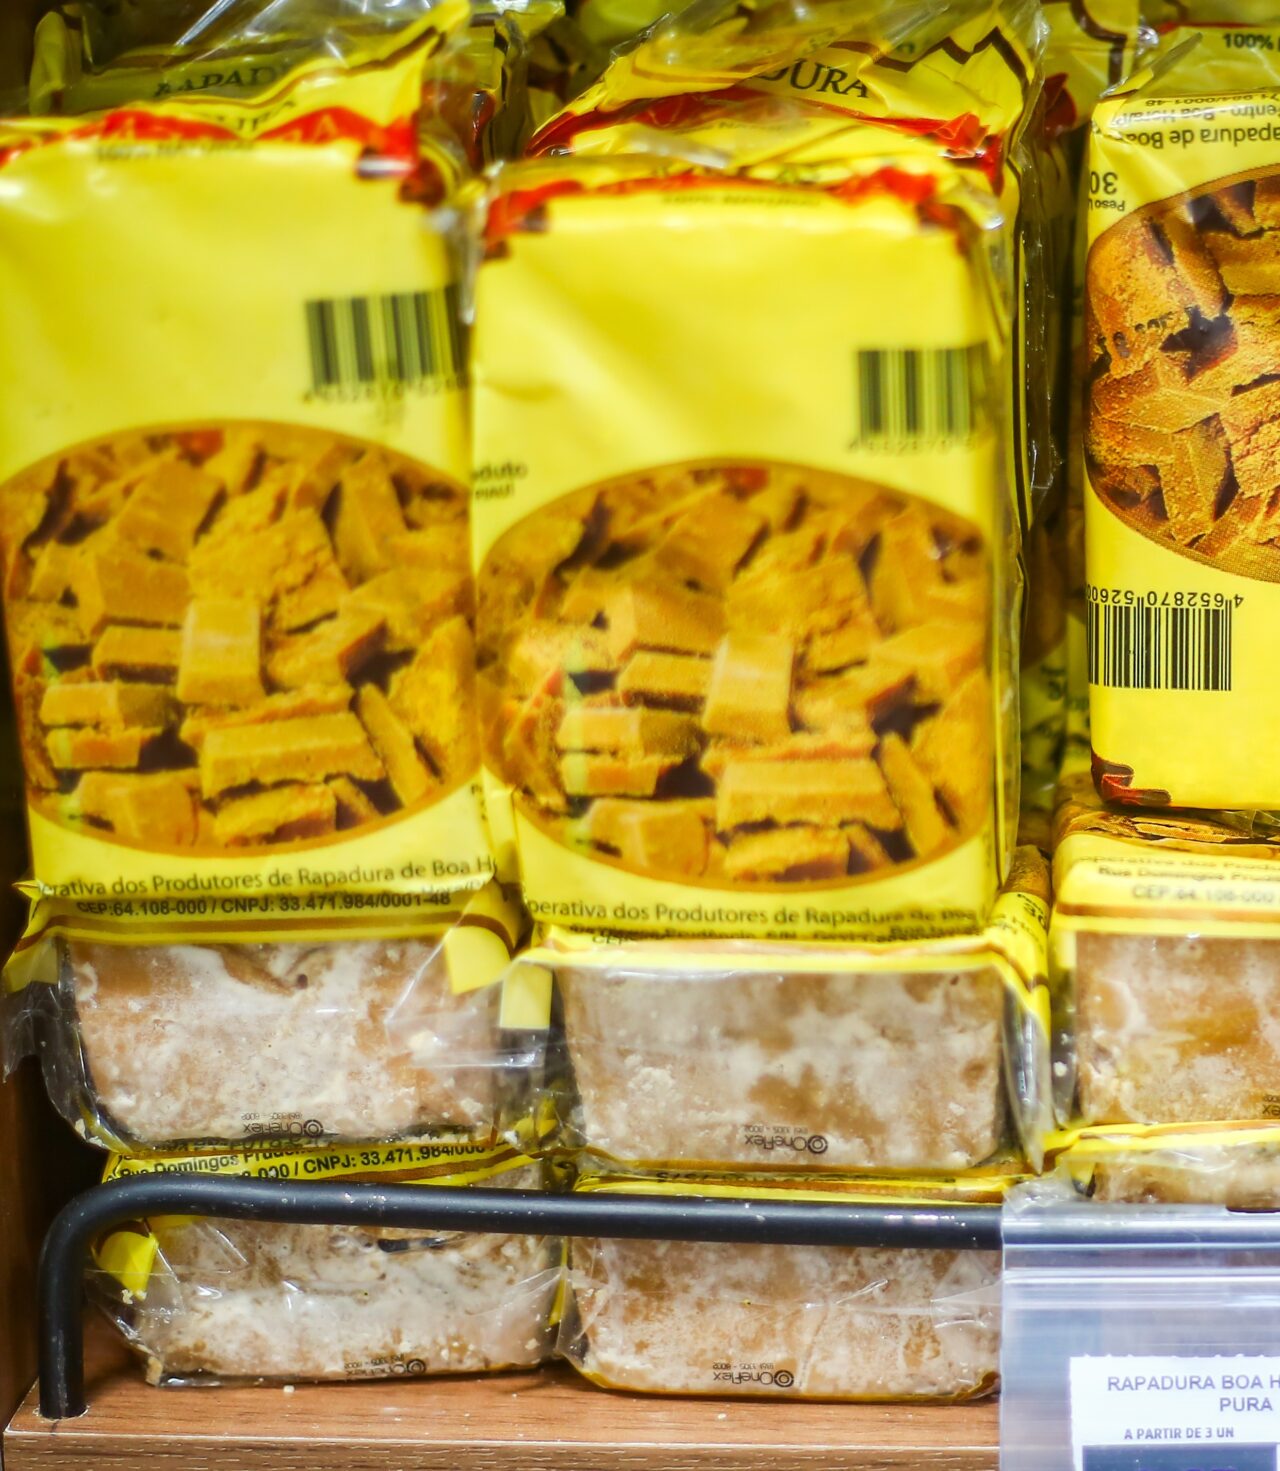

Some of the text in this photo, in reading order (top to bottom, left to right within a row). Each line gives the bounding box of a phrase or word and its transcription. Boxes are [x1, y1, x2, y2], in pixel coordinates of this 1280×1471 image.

[1222, 32, 1274, 50] 100%
[1169, 129, 1195, 148] de
[1146, 590, 1225, 608] 652870
[1233, 593, 1245, 609] 4
[111, 875, 148, 895] dos
[151, 867, 263, 893] Produtores
[267, 868, 293, 887] de
[298, 865, 395, 887] Rapadura
[400, 860, 427, 878] de
[432, 858, 471, 876] Boa
[76, 889, 451, 917] CEP:64.108-000 CNPJ: 33.471.984/0001-48
[613, 901, 650, 922] dos
[655, 904, 769, 925] Produtores
[774, 907, 800, 924] de
[242, 1121, 304, 1141] OneFlex
[744, 1134, 808, 1152] OneFlex
[153, 1153, 240, 1173] Domingos
[303, 1154, 358, 1175] CNPJ:
[712, 1371, 774, 1386] OneFlex
[1107, 1374, 1217, 1391] RAPADURA
[1221, 1374, 1264, 1390] BOA
[1219, 1396, 1274, 1412] PURA
[1123, 1426, 1235, 1441] A PARTIR DE 3 UN
